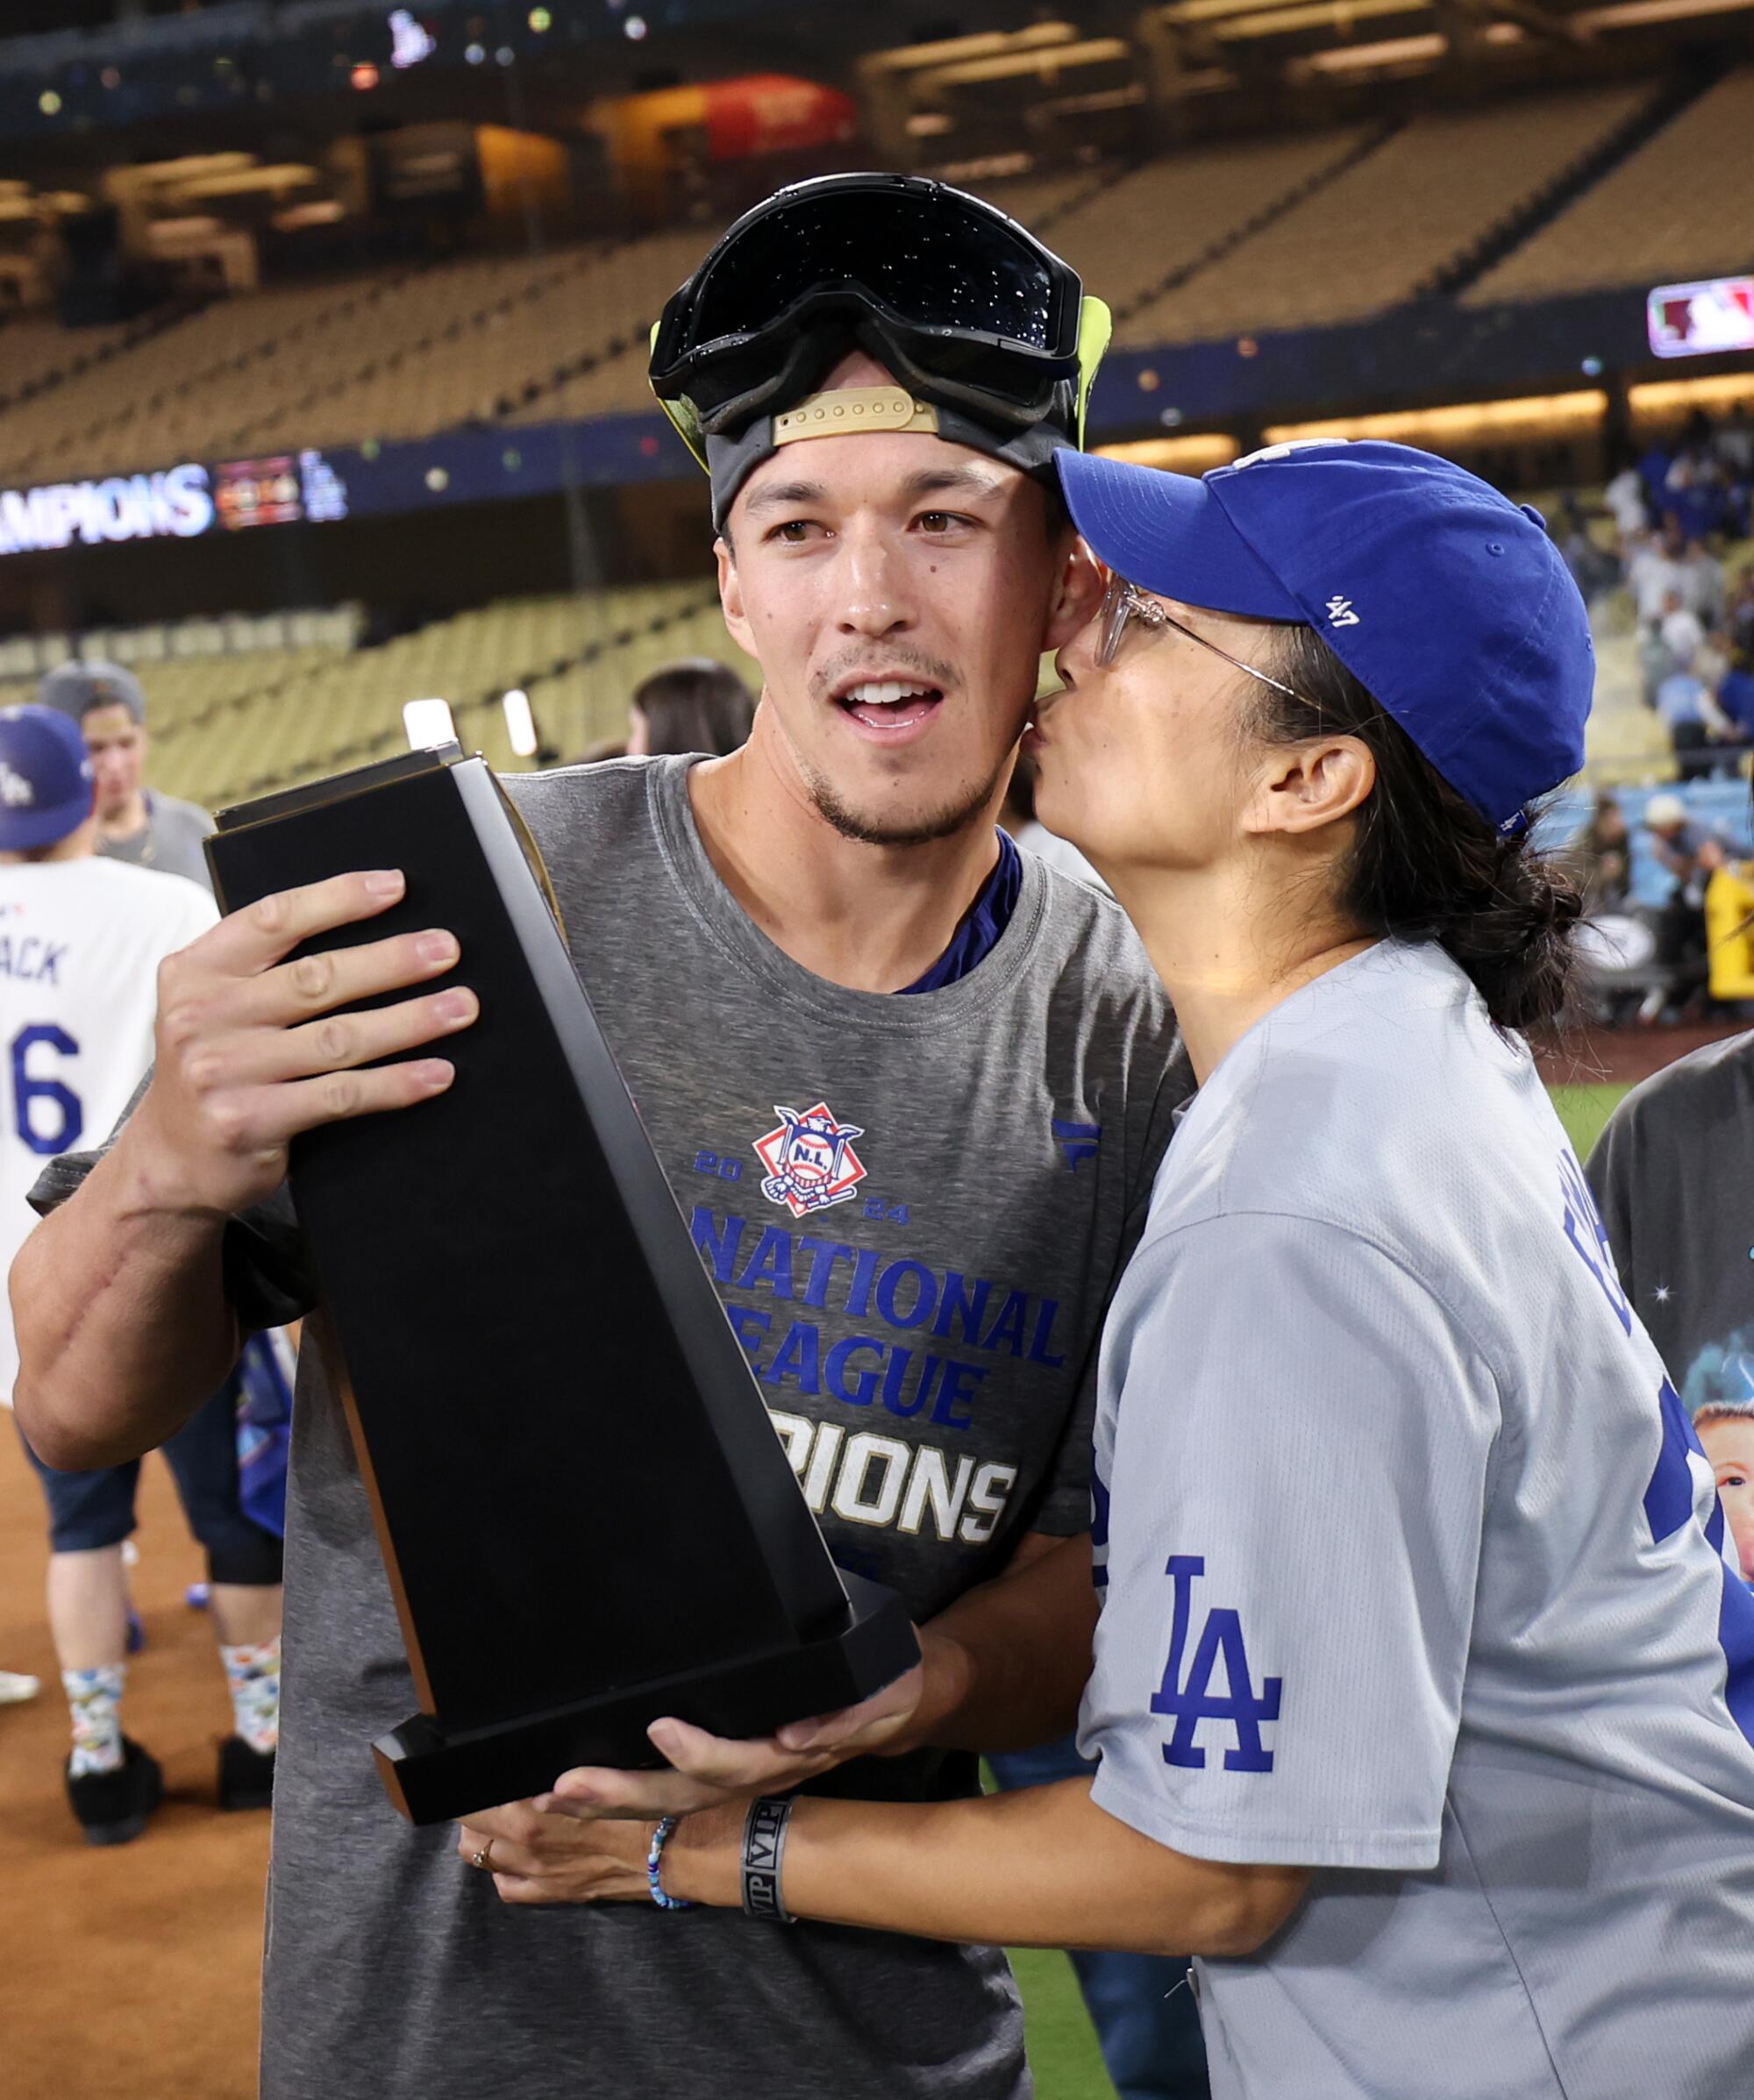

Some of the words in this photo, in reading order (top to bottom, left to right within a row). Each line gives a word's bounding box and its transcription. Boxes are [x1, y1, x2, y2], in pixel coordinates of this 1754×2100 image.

[693, 1150, 743, 1181] 20
[793, 1143, 828, 1171] N.L.
[862, 1196, 910, 1226] 24
[690, 1207, 1066, 1368] NATIONAL
[1150, 1555, 1282, 1772] LA
[750, 1805, 780, 1864] VIP
